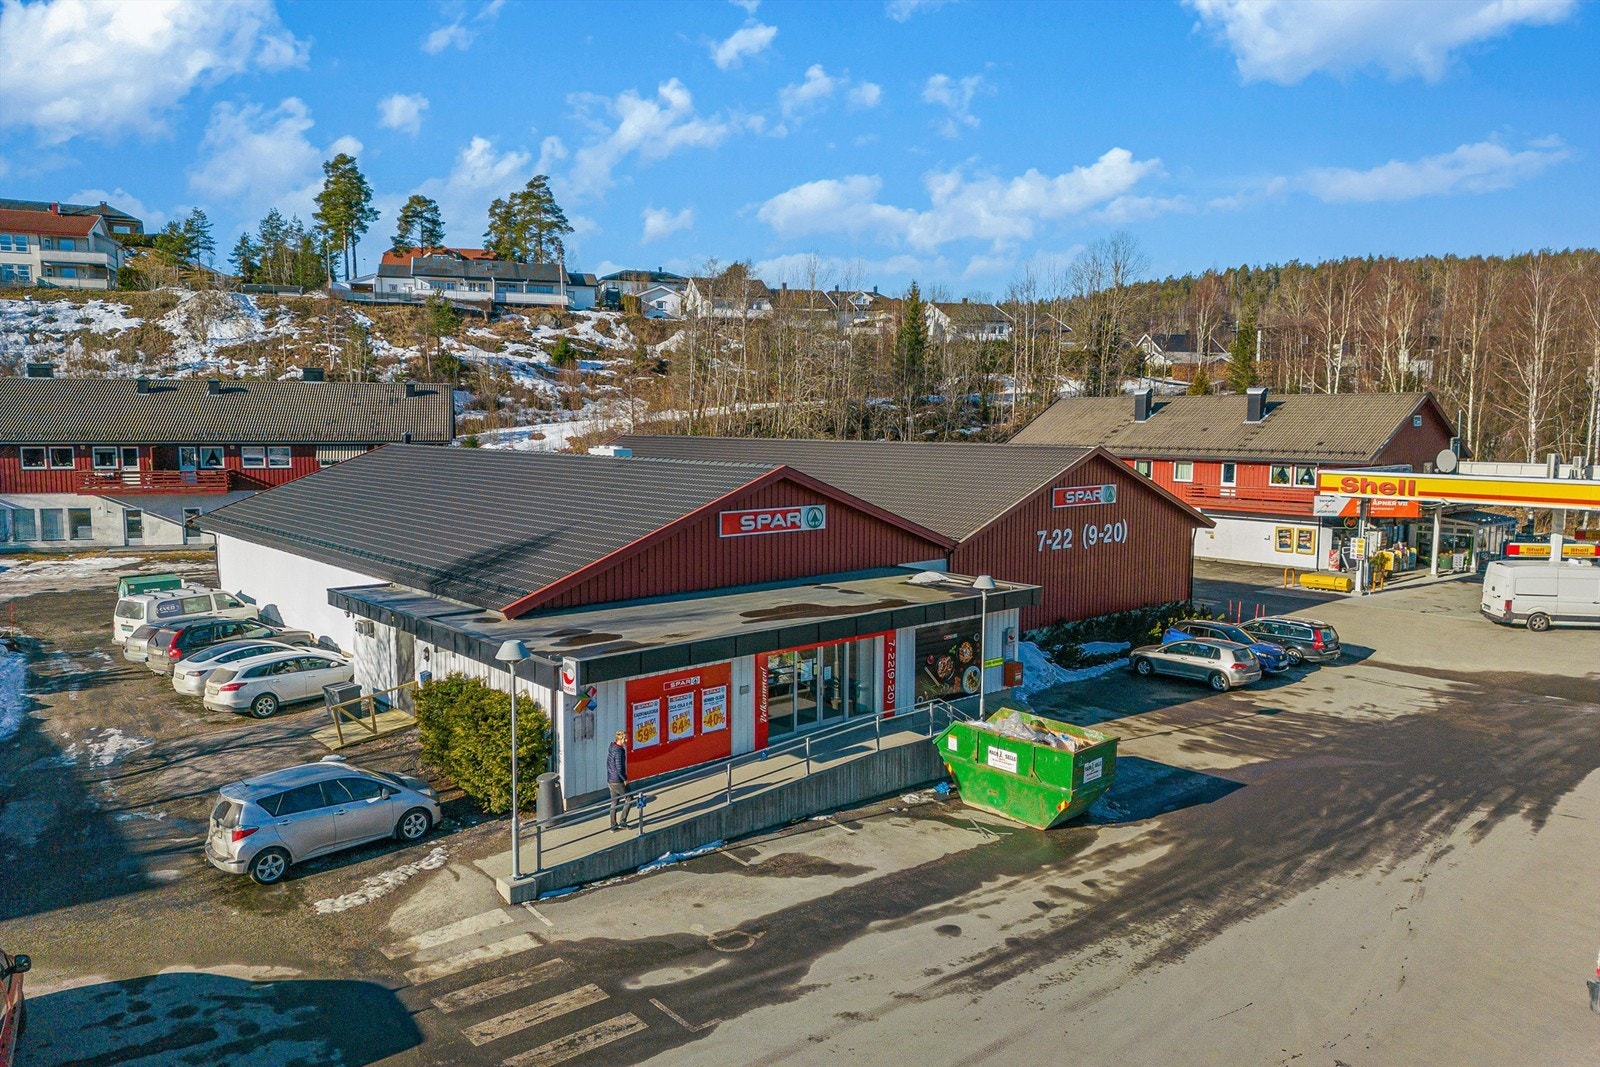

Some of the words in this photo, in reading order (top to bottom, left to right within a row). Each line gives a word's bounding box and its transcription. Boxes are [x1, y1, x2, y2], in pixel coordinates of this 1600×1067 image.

[1340, 476, 1416, 497] Shell
[1065, 489, 1101, 504] SPAR
[740, 511, 801, 531] SPAR
[1037, 528, 1073, 552] 7-22
[1082, 518, 1128, 550] (9-20)
[670, 679, 691, 688] SPAR
[703, 712, 725, 726] -40%
